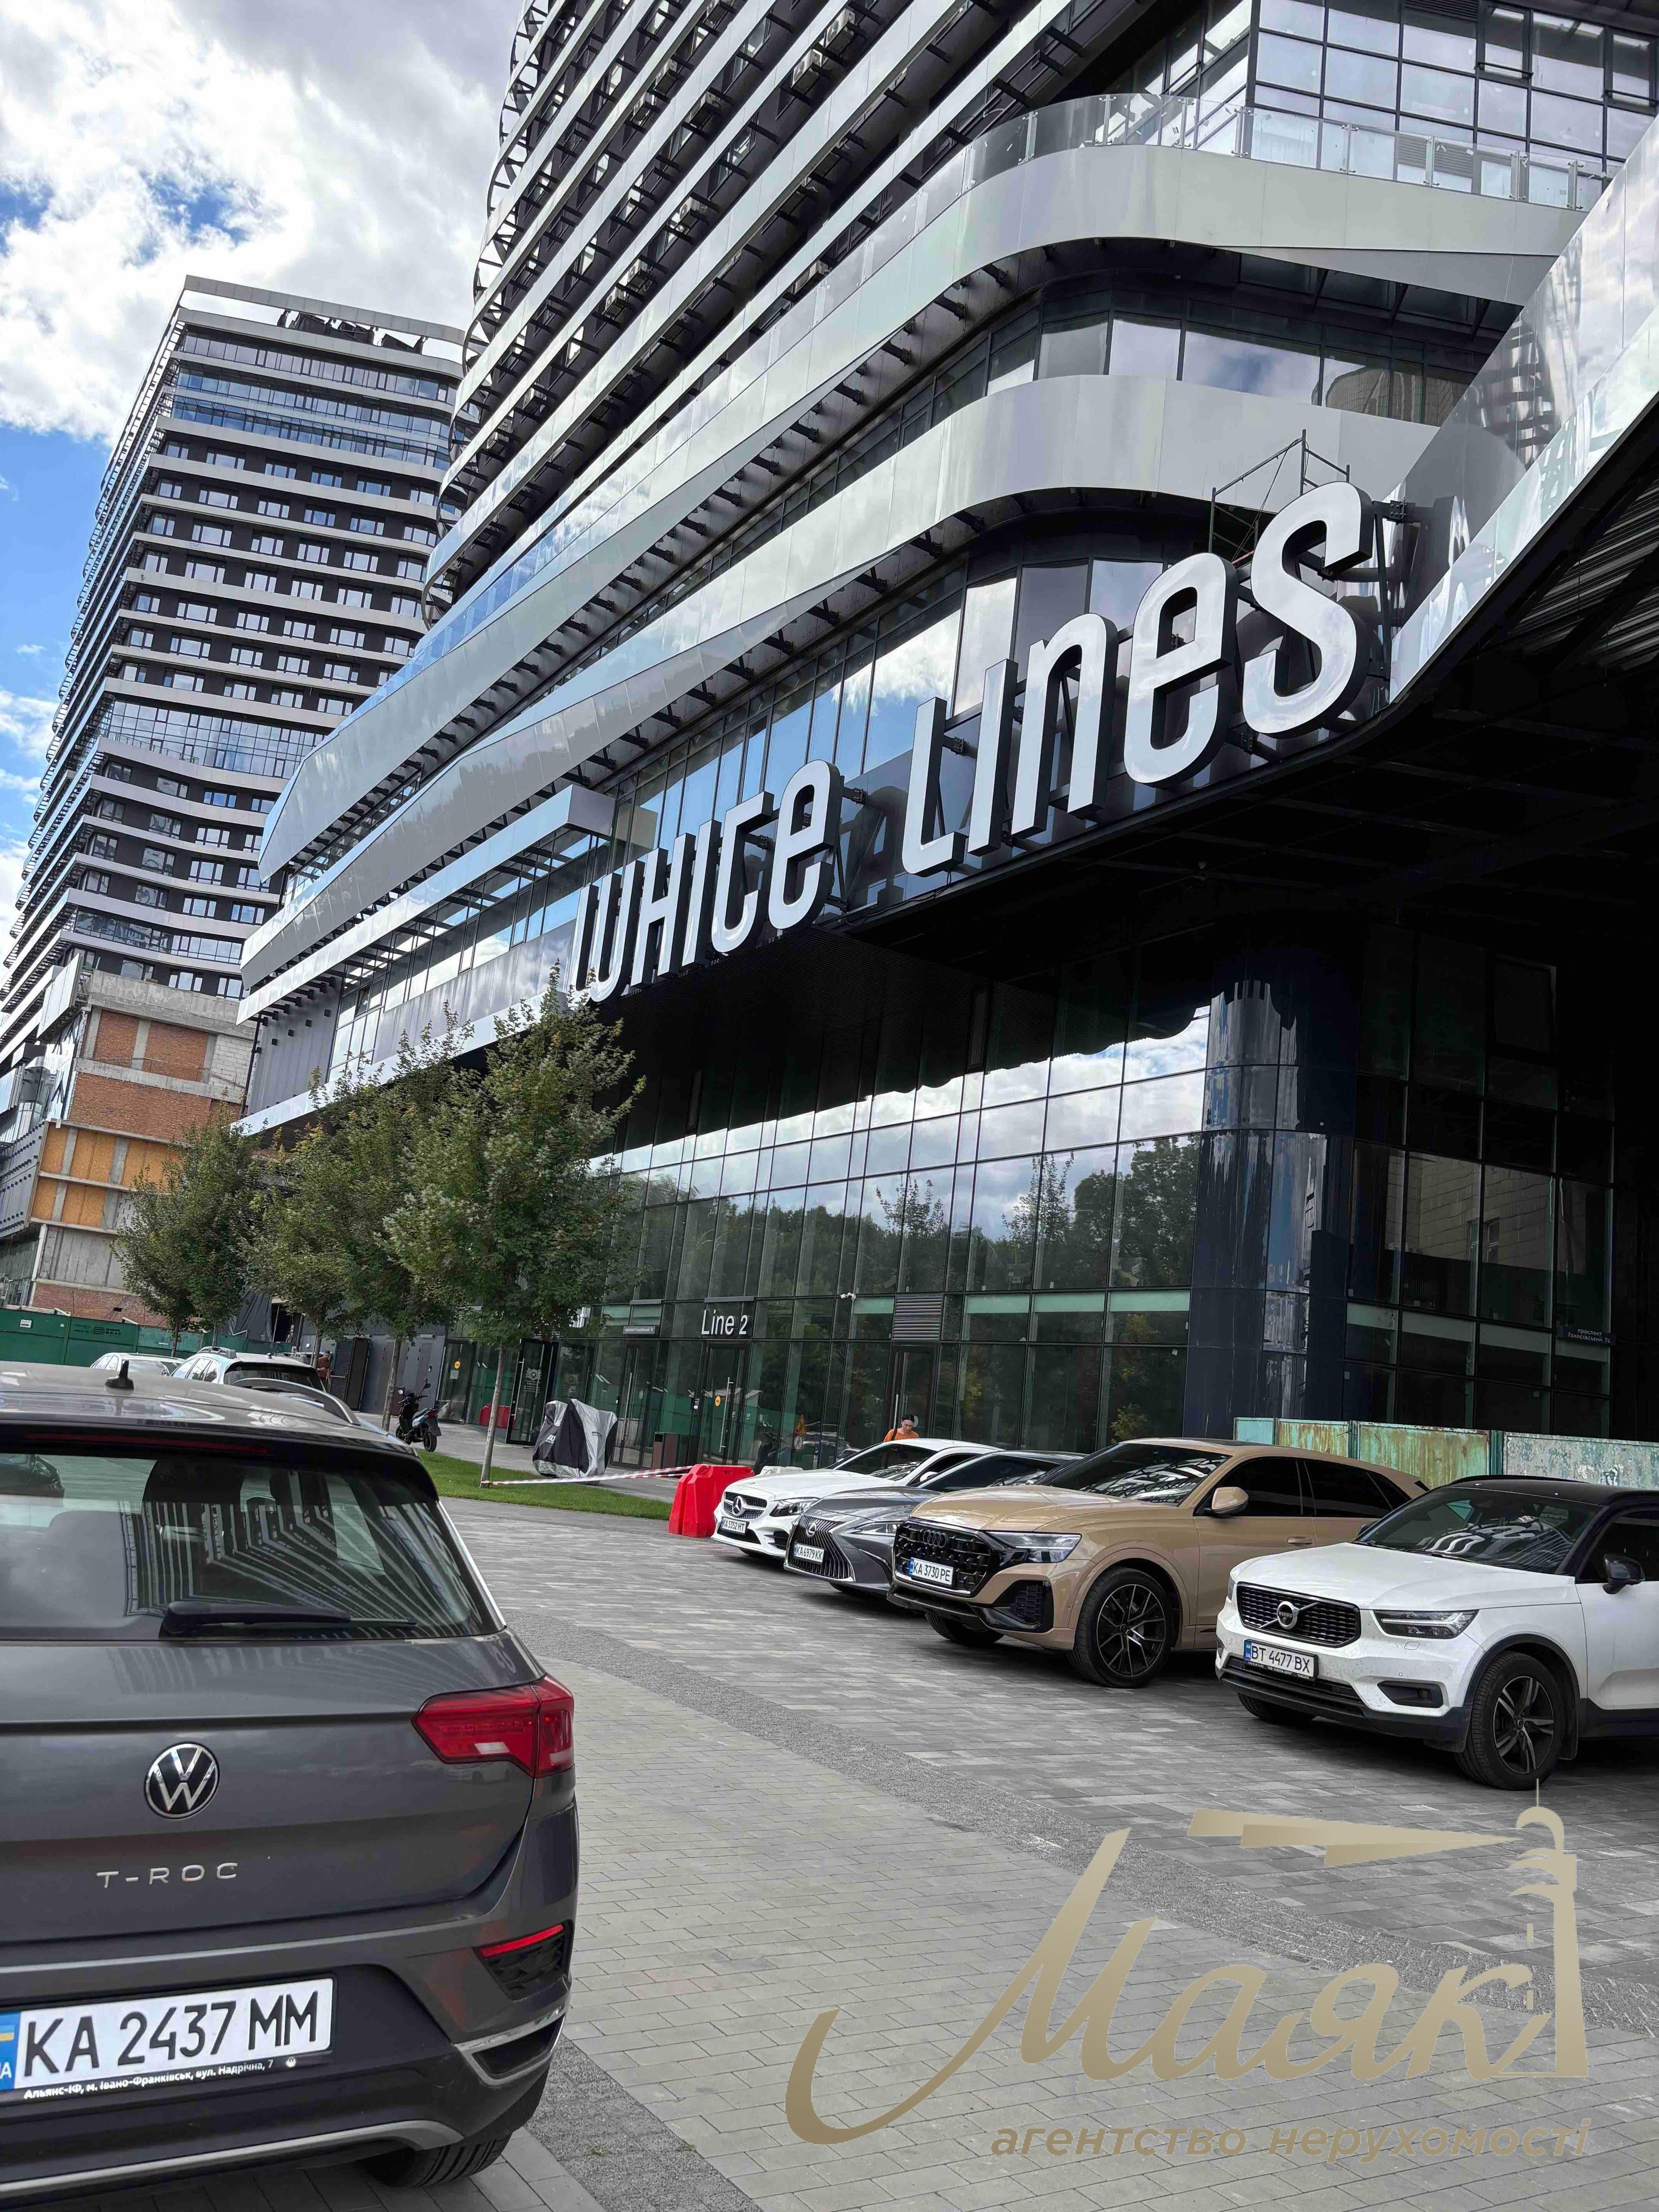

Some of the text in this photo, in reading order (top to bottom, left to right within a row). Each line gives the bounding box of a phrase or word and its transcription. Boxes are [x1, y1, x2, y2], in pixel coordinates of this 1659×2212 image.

[702, 1309, 748, 1335] Line 2
[797, 1546, 823, 1560] KA 6979 KK
[913, 1562, 950, 1582] KA 3730 PE
[1252, 1646, 1266, 1661] BT
[1268, 1650, 1292, 1668] 4477
[1294, 1656, 1310, 1673] BX
[96, 1862, 238, 1888] T-ROC
[24, 1990, 318, 2076] KA 2437 MM
[218, 2062, 265, 2076] Надрічна,
[268, 2059, 273, 2069] 7
